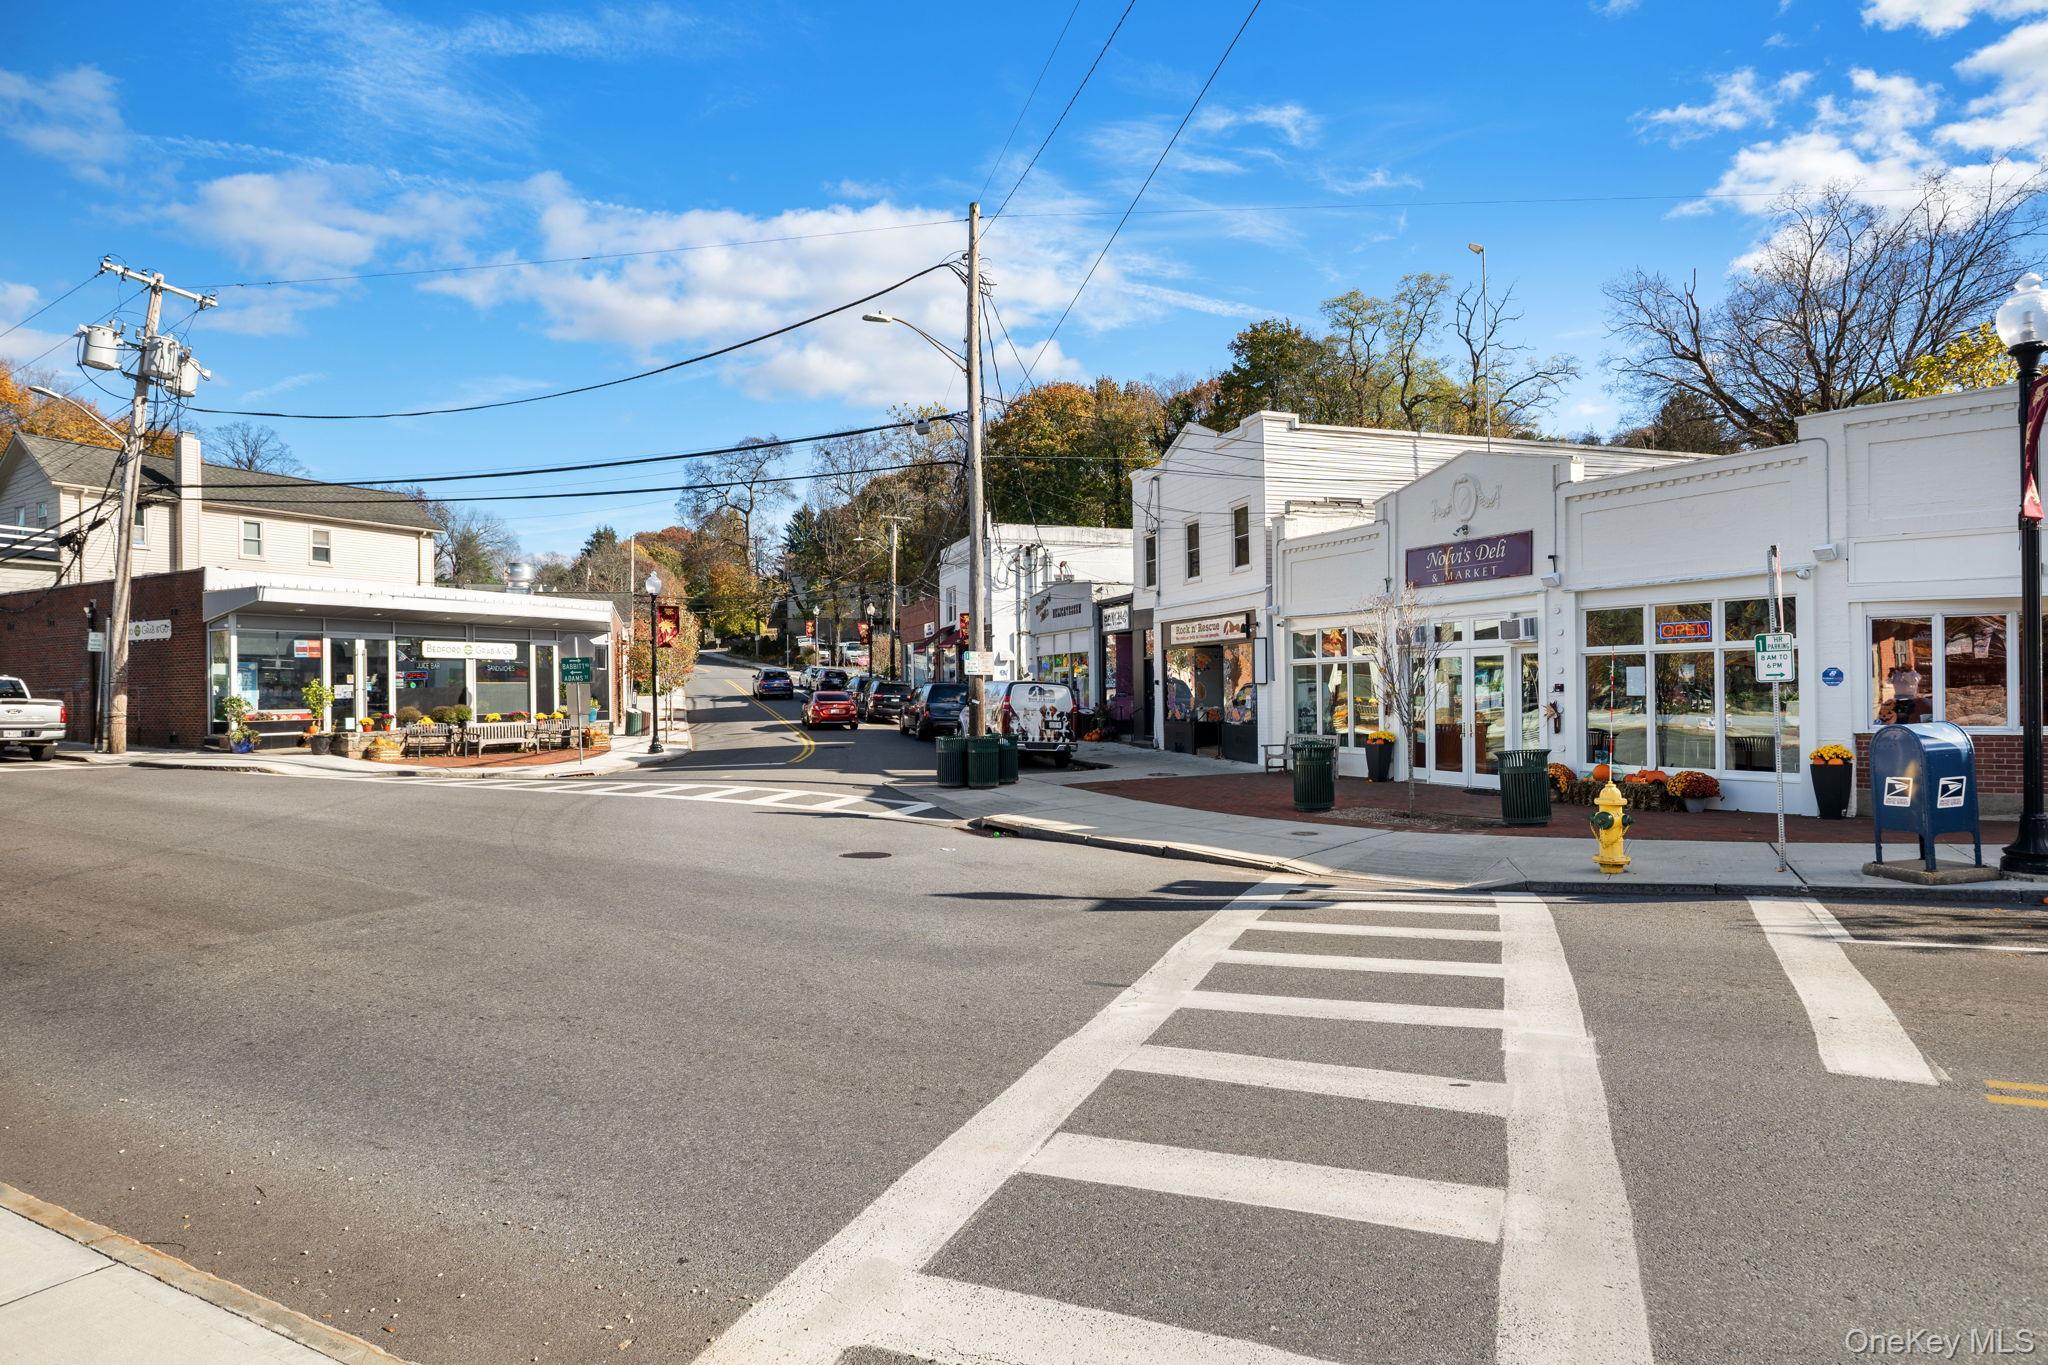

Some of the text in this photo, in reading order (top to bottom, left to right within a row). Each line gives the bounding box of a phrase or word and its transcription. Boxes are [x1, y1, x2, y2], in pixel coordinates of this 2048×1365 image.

[1426, 538, 1506, 569] Nolvi's Deli
[1431, 565, 1498, 583] & MARKET
[1175, 625, 1190, 635] Rock
[1197, 622, 1220, 633] Rescue
[1662, 623, 1708, 637] OPEN
[426, 644, 461, 654] BEDFORD
[486, 664, 515, 672] SANDWICHES
